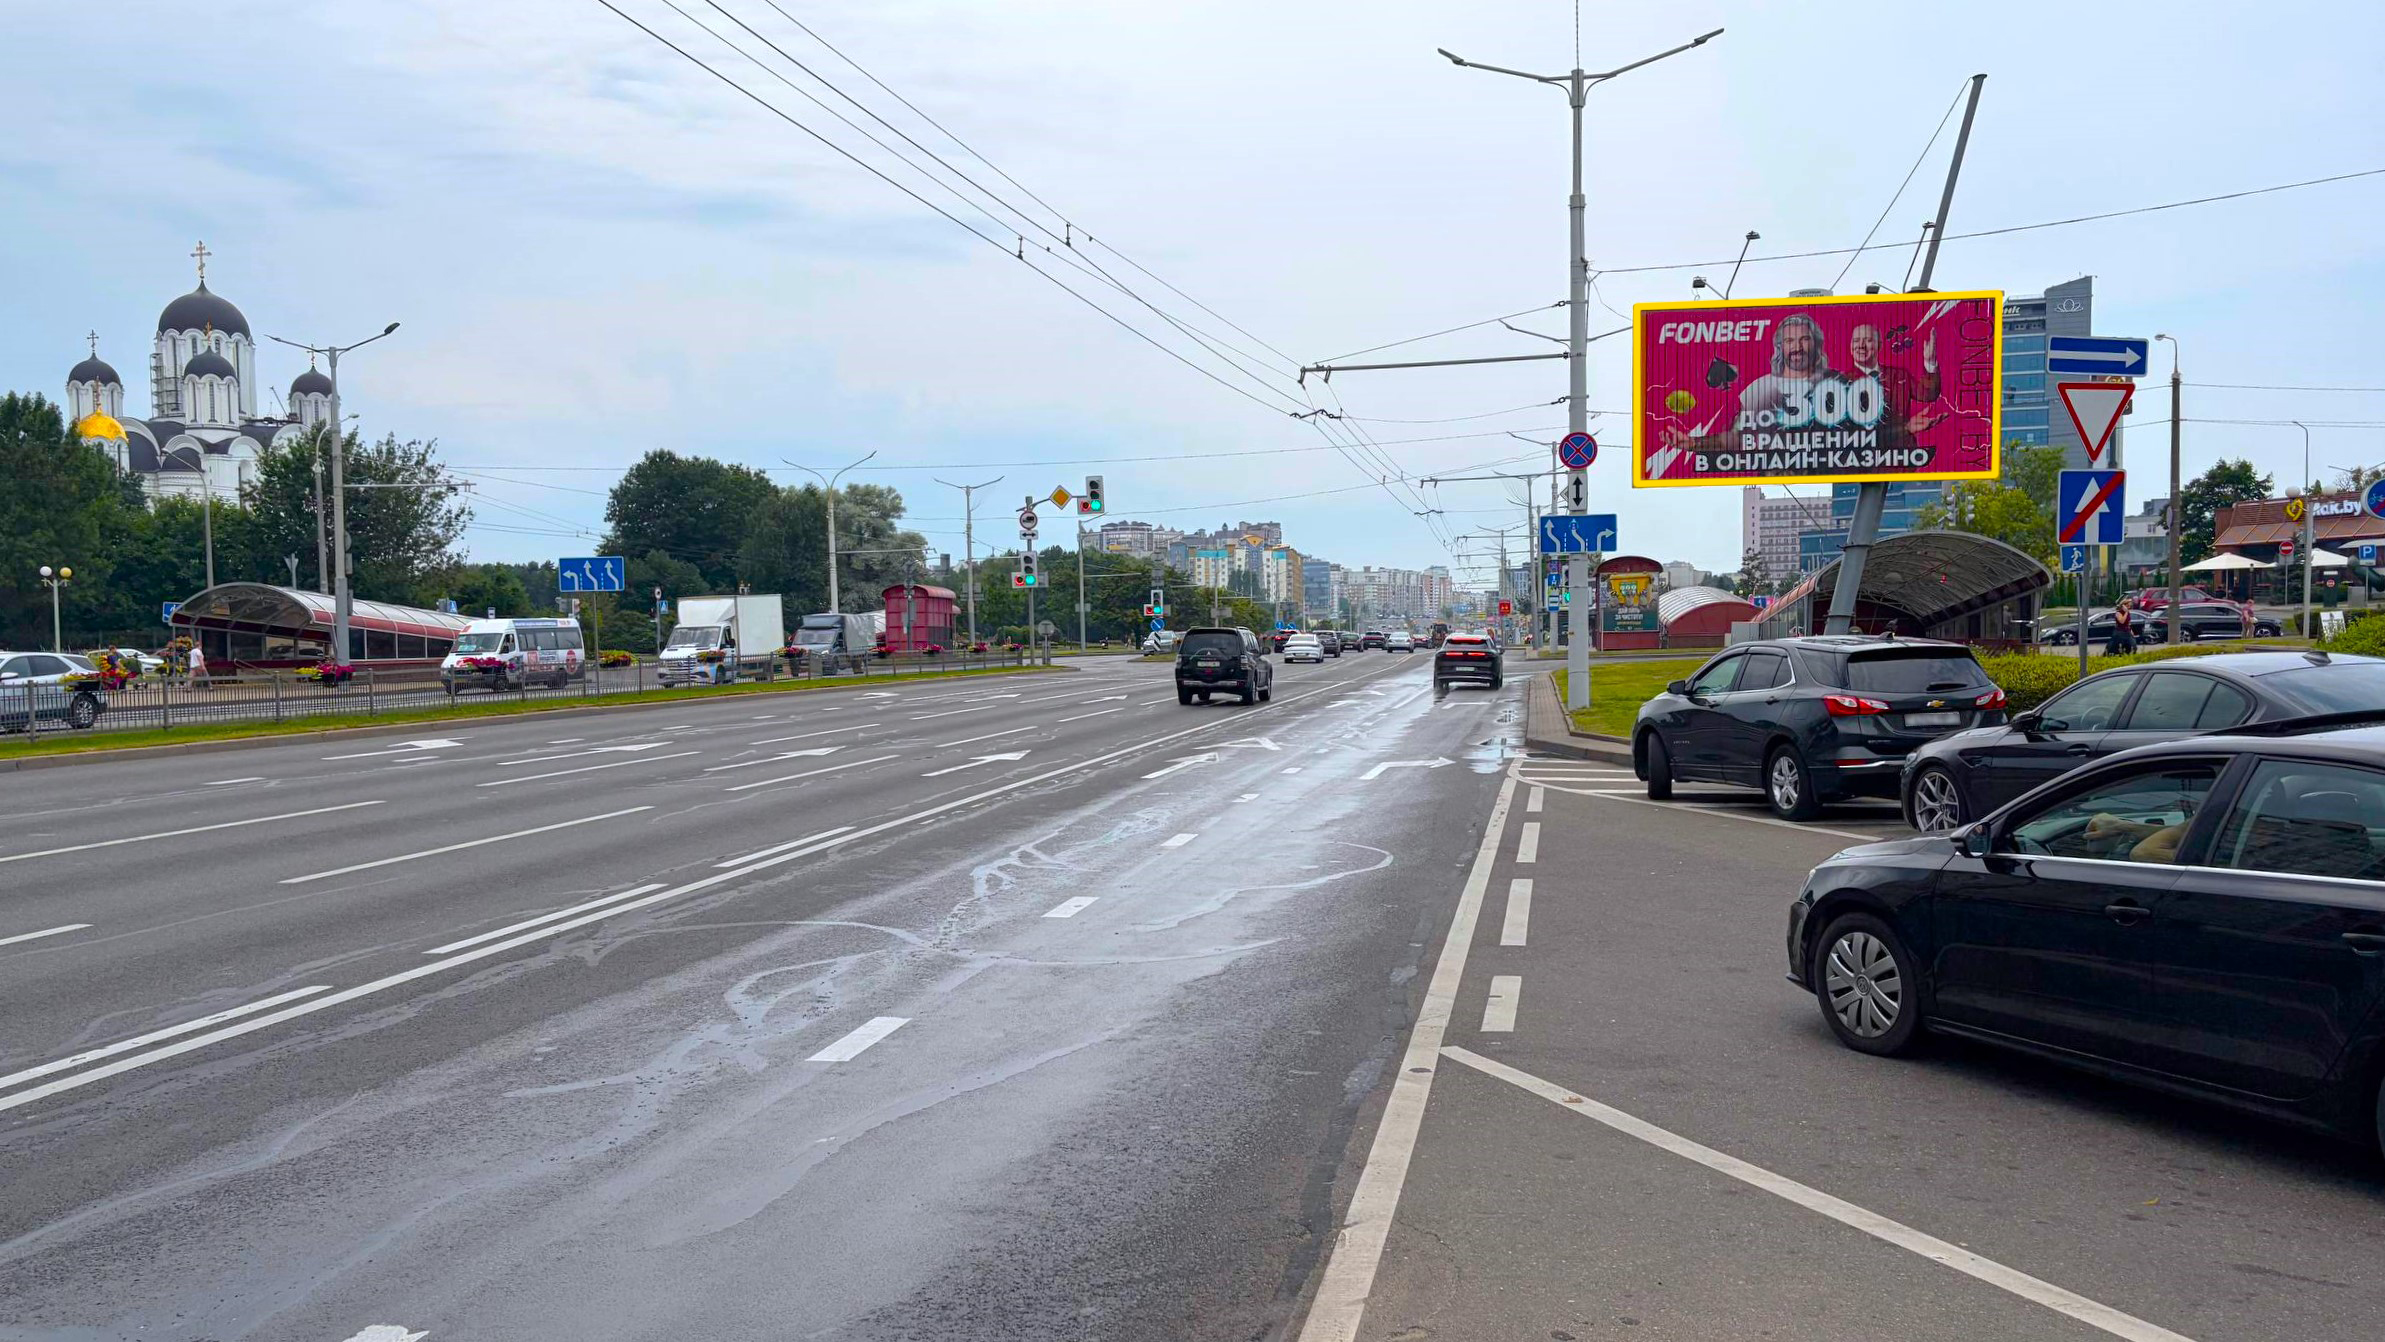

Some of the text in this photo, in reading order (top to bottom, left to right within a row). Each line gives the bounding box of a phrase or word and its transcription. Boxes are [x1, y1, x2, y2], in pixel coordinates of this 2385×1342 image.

[1659, 320, 1771, 344] FONBET
[1740, 378, 1884, 431] ДО 300
[1742, 426, 1877, 452] ВРАЩЕНИЙ
[1695, 454, 1709, 471] В
